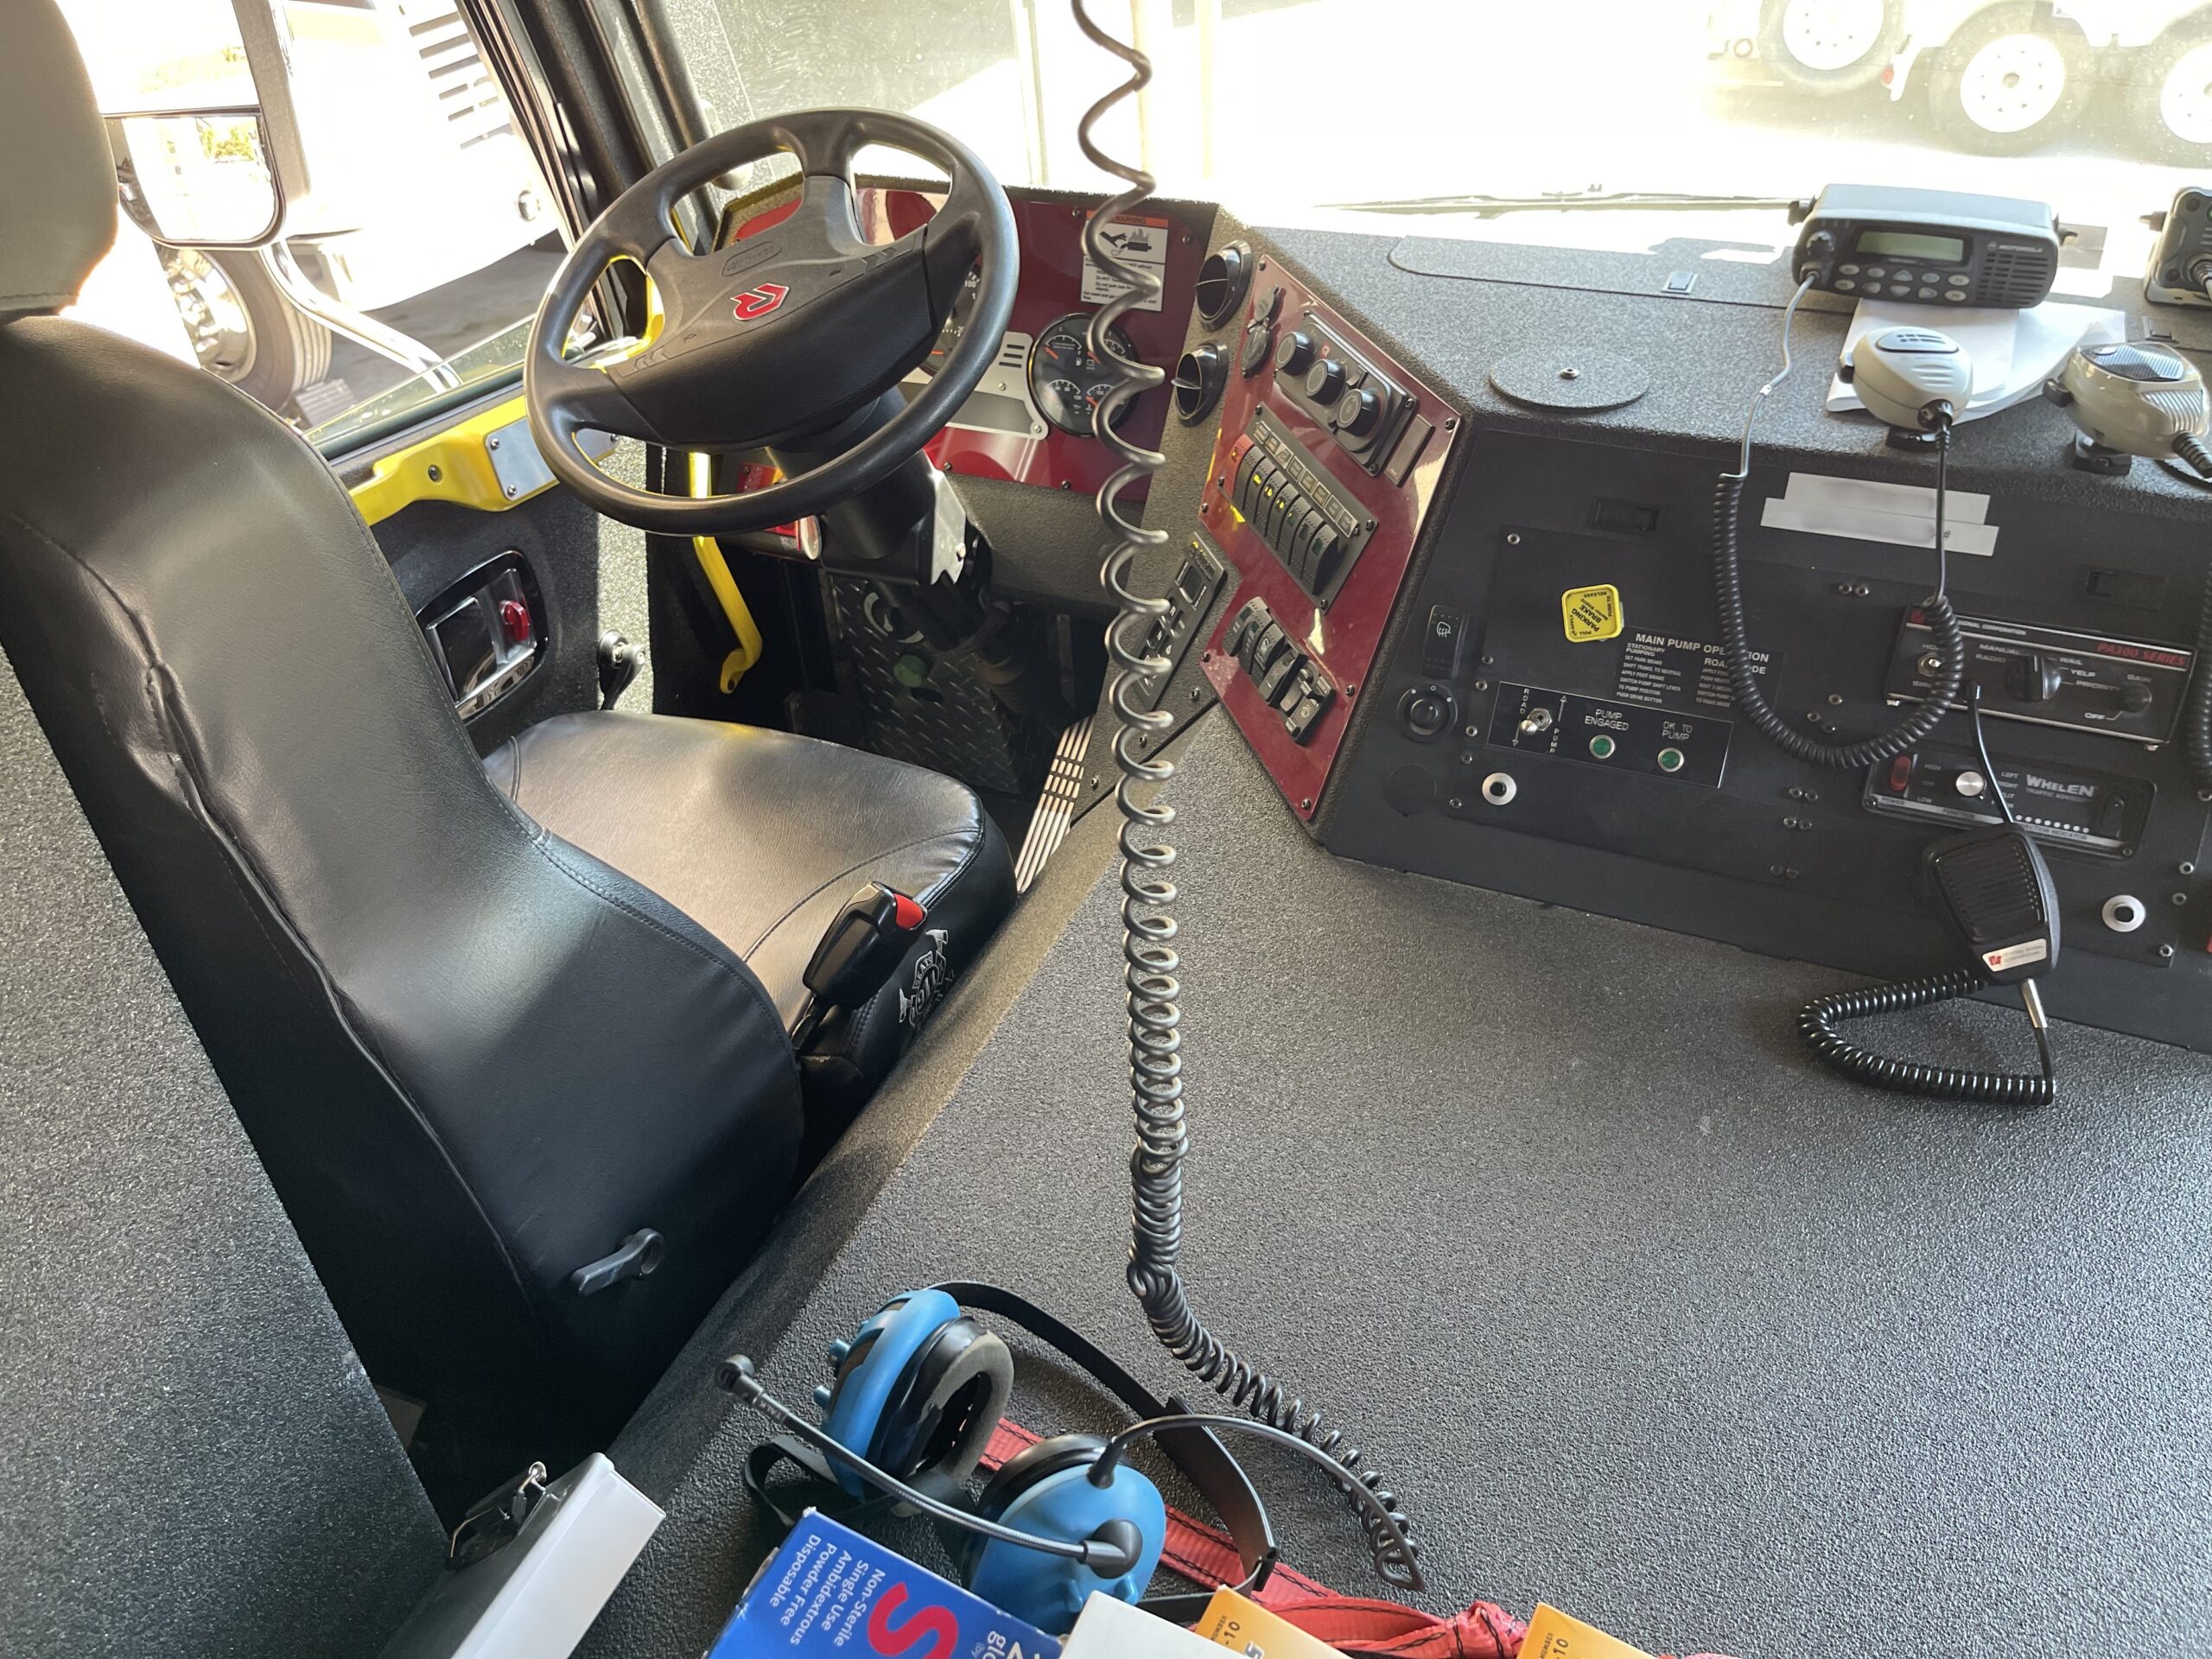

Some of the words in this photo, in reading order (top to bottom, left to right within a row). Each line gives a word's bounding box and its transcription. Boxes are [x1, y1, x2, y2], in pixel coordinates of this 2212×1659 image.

[1572, 608, 1600, 632] PARKING
[1580, 604, 1602, 623] BRAKE
[1625, 647, 1656, 657] PUMPING
[1627, 642, 1665, 653] STATIONARY
[1636, 633, 1665, 646] MAIN
[1667, 638, 1701, 652] PUMP
[1979, 644, 2021, 655] MANUAL
[1704, 658, 1728, 668] ROA
[1975, 653, 2006, 664] RADIO
[2142, 650, 2186, 666] SERIES
[2070, 669, 2096, 677] YELP
[2075, 680, 2120, 691] PRIORITY
[1519, 688, 1529, 715] ROAD
[1584, 715, 1630, 731] ENGAGED
[1595, 709, 1623, 720] PUMP
[1662, 721, 1675, 730] OK
[1682, 724, 1694, 734] TO
[1662, 729, 1689, 741] PUMP
[1549, 728, 1560, 753] PUMP
[2025, 773, 2095, 798] WHELEN
[769, 1534, 822, 1607] Disposable
[800, 1542, 837, 1595] Powder
[837, 1559, 869, 1603] Single
[790, 1550, 853, 1646] Ambidextrous
[780, 1594, 805, 1626] Free
[821, 1604, 845, 1631] Use
[834, 1568, 887, 1648] Non-Sterile
